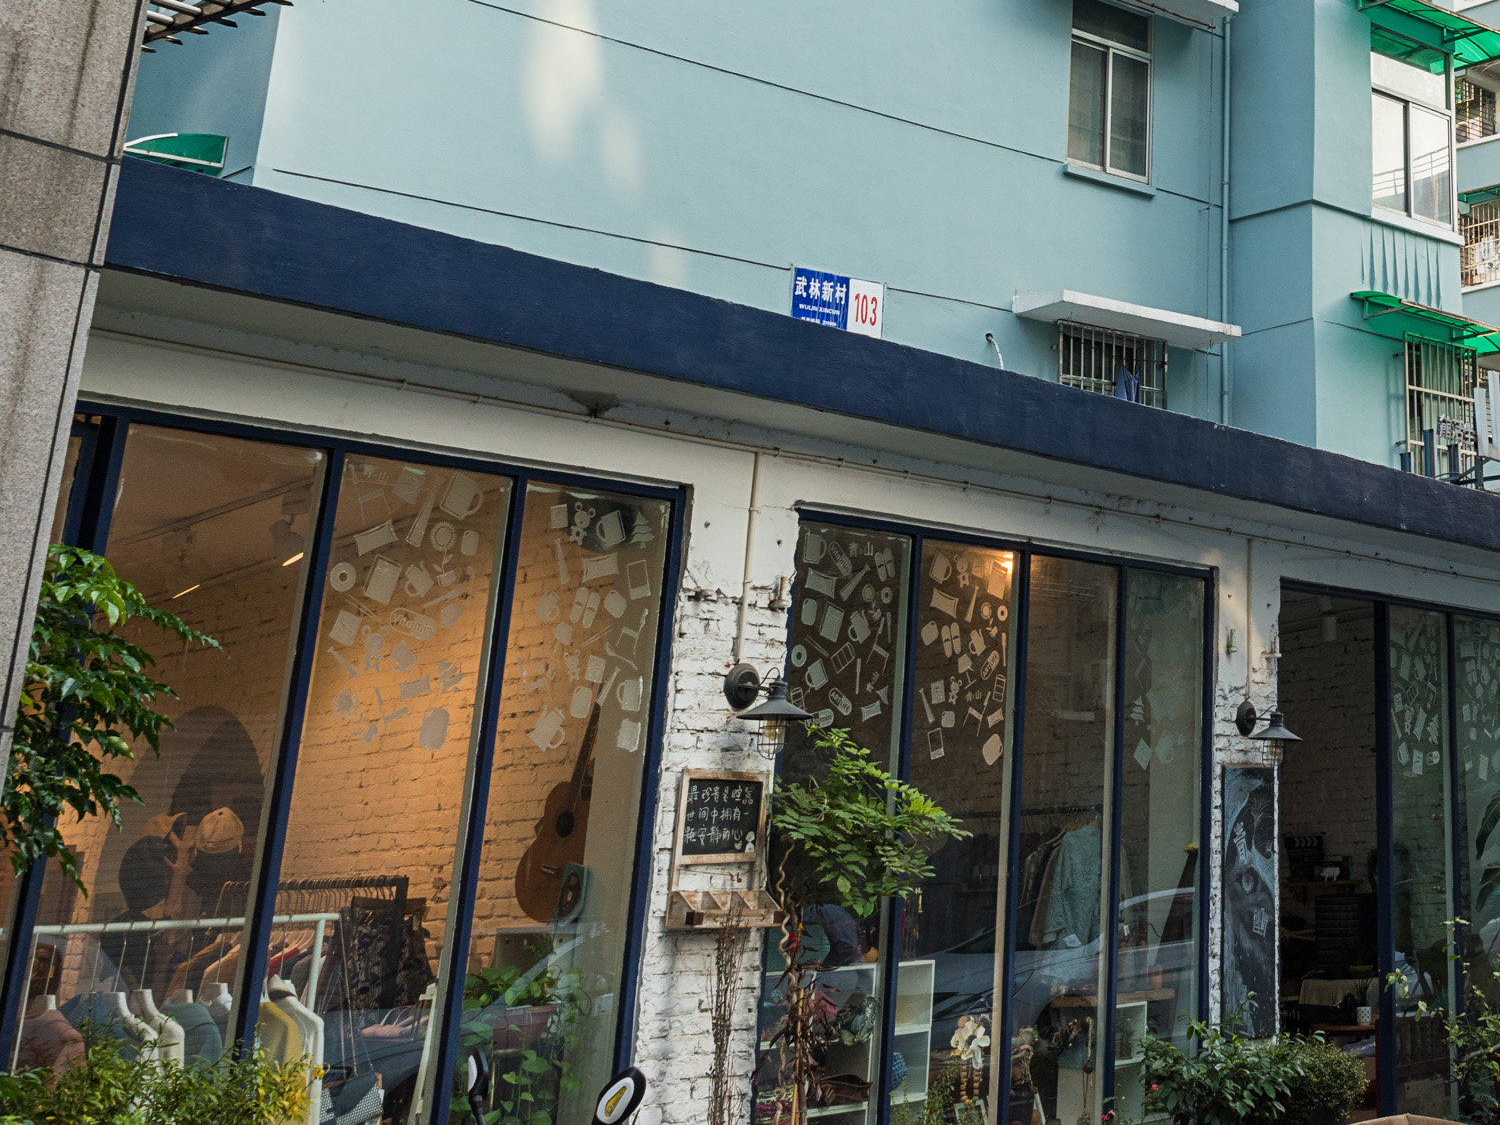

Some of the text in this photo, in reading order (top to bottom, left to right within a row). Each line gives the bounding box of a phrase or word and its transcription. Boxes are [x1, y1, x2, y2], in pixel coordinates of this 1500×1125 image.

[794, 275, 847, 305] 武林新村
[854, 292, 878, 326] 103
[393, 611, 434, 635] Vitamin
